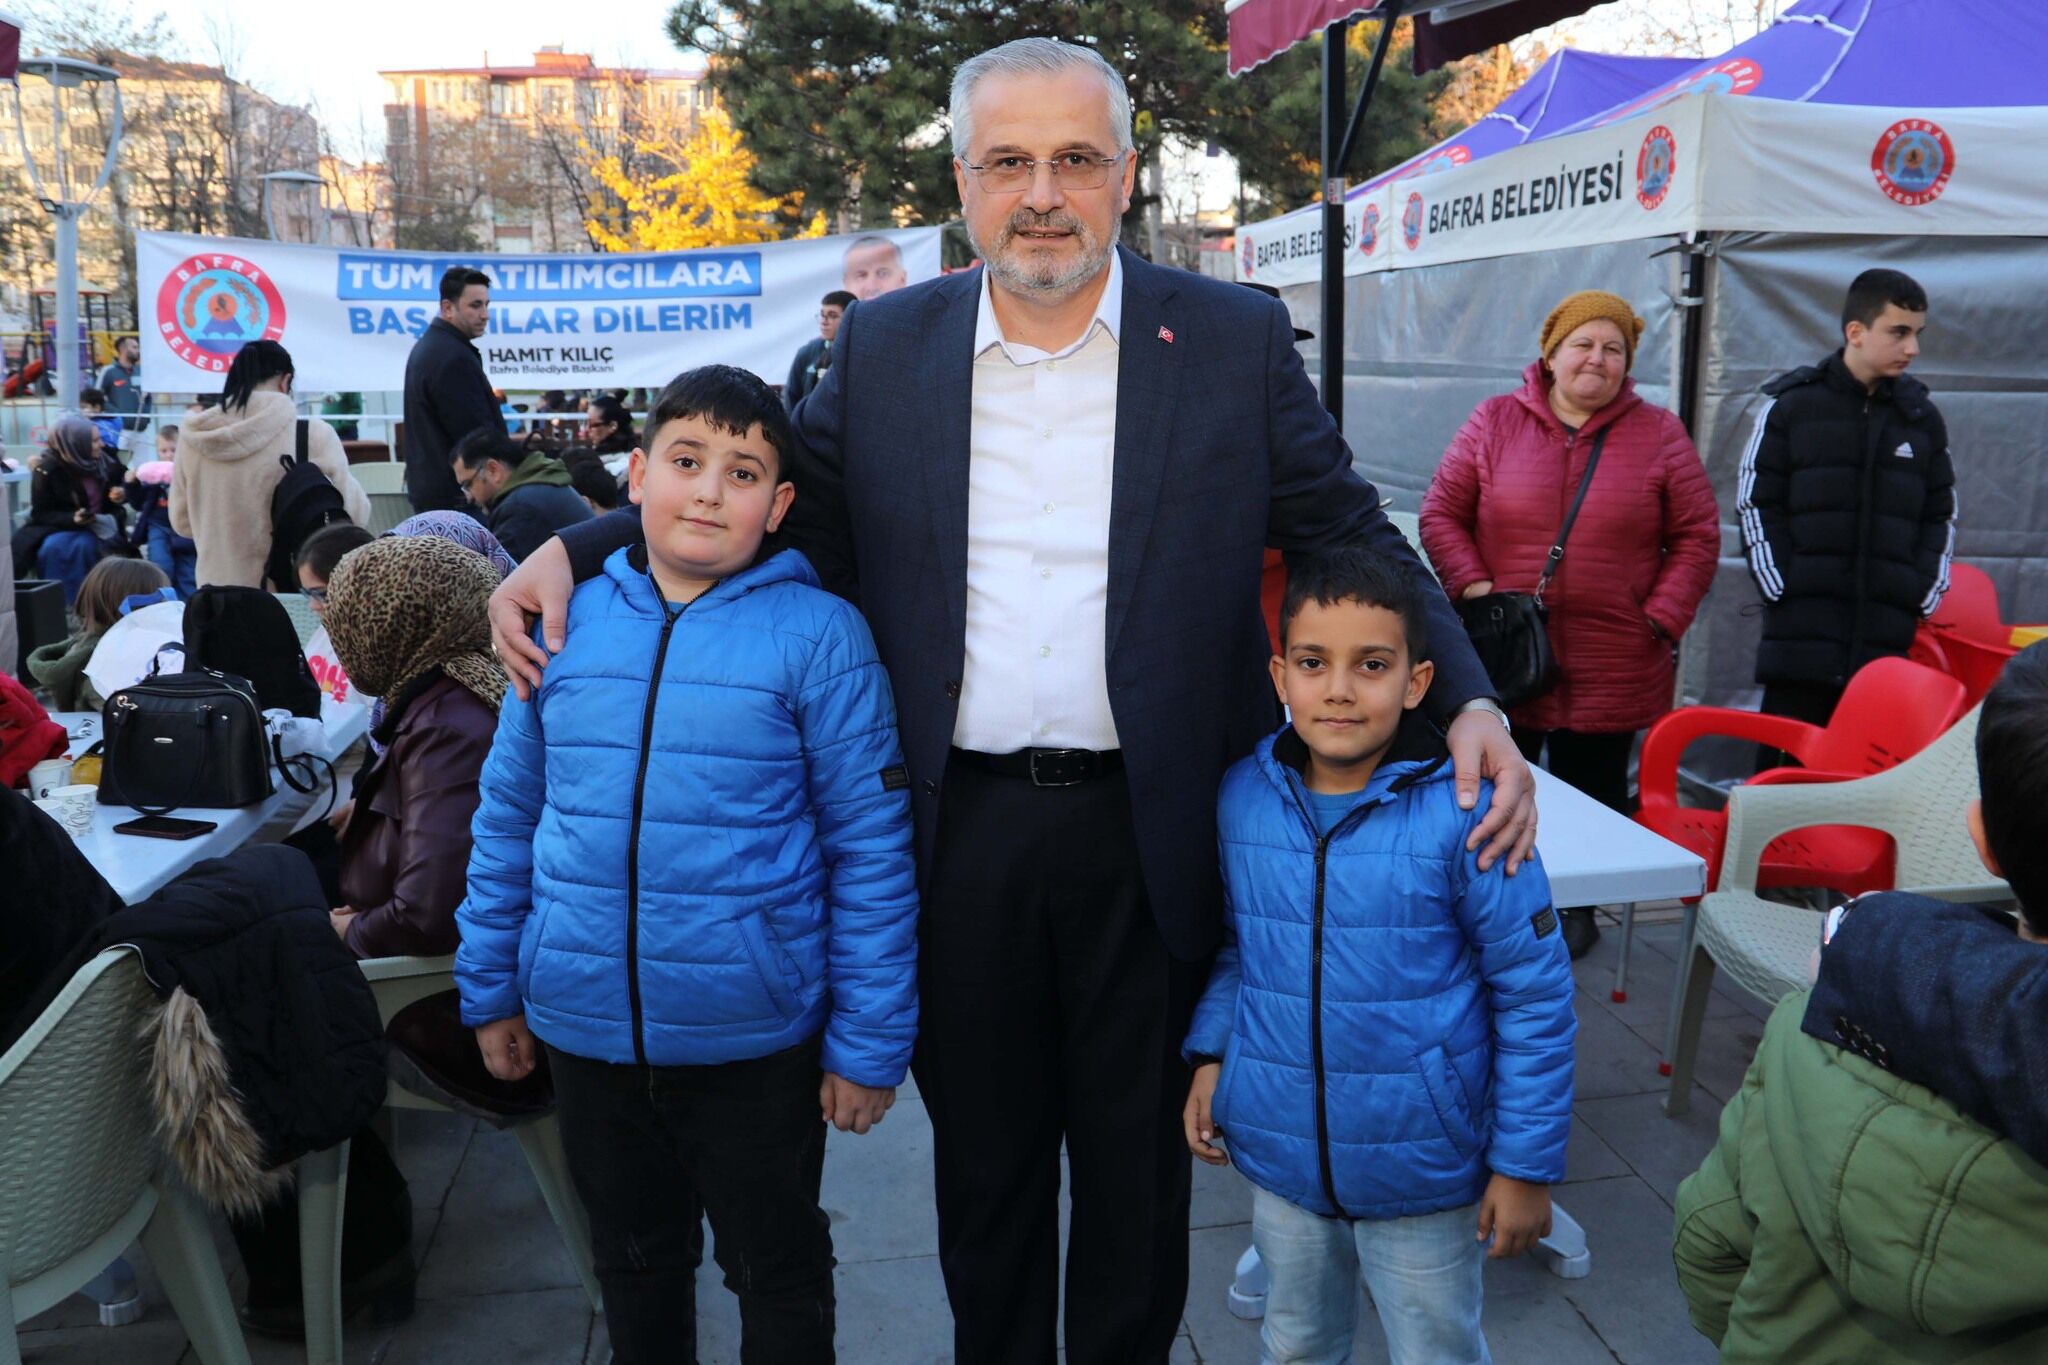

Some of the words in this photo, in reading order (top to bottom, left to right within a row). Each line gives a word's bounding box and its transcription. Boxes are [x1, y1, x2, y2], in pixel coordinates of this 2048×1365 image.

[1429, 193, 1484, 234] BAFRA
[1490, 150, 1623, 222] BELEDİYESİ
[1257, 239, 1287, 268] BAFRA
[176, 256, 260, 282] BAFRA
[345, 262, 434, 290] TÜM
[561, 346, 614, 364] KILIÇ
[490, 365, 519, 375] Bafra
[522, 364, 569, 376] Belediye
